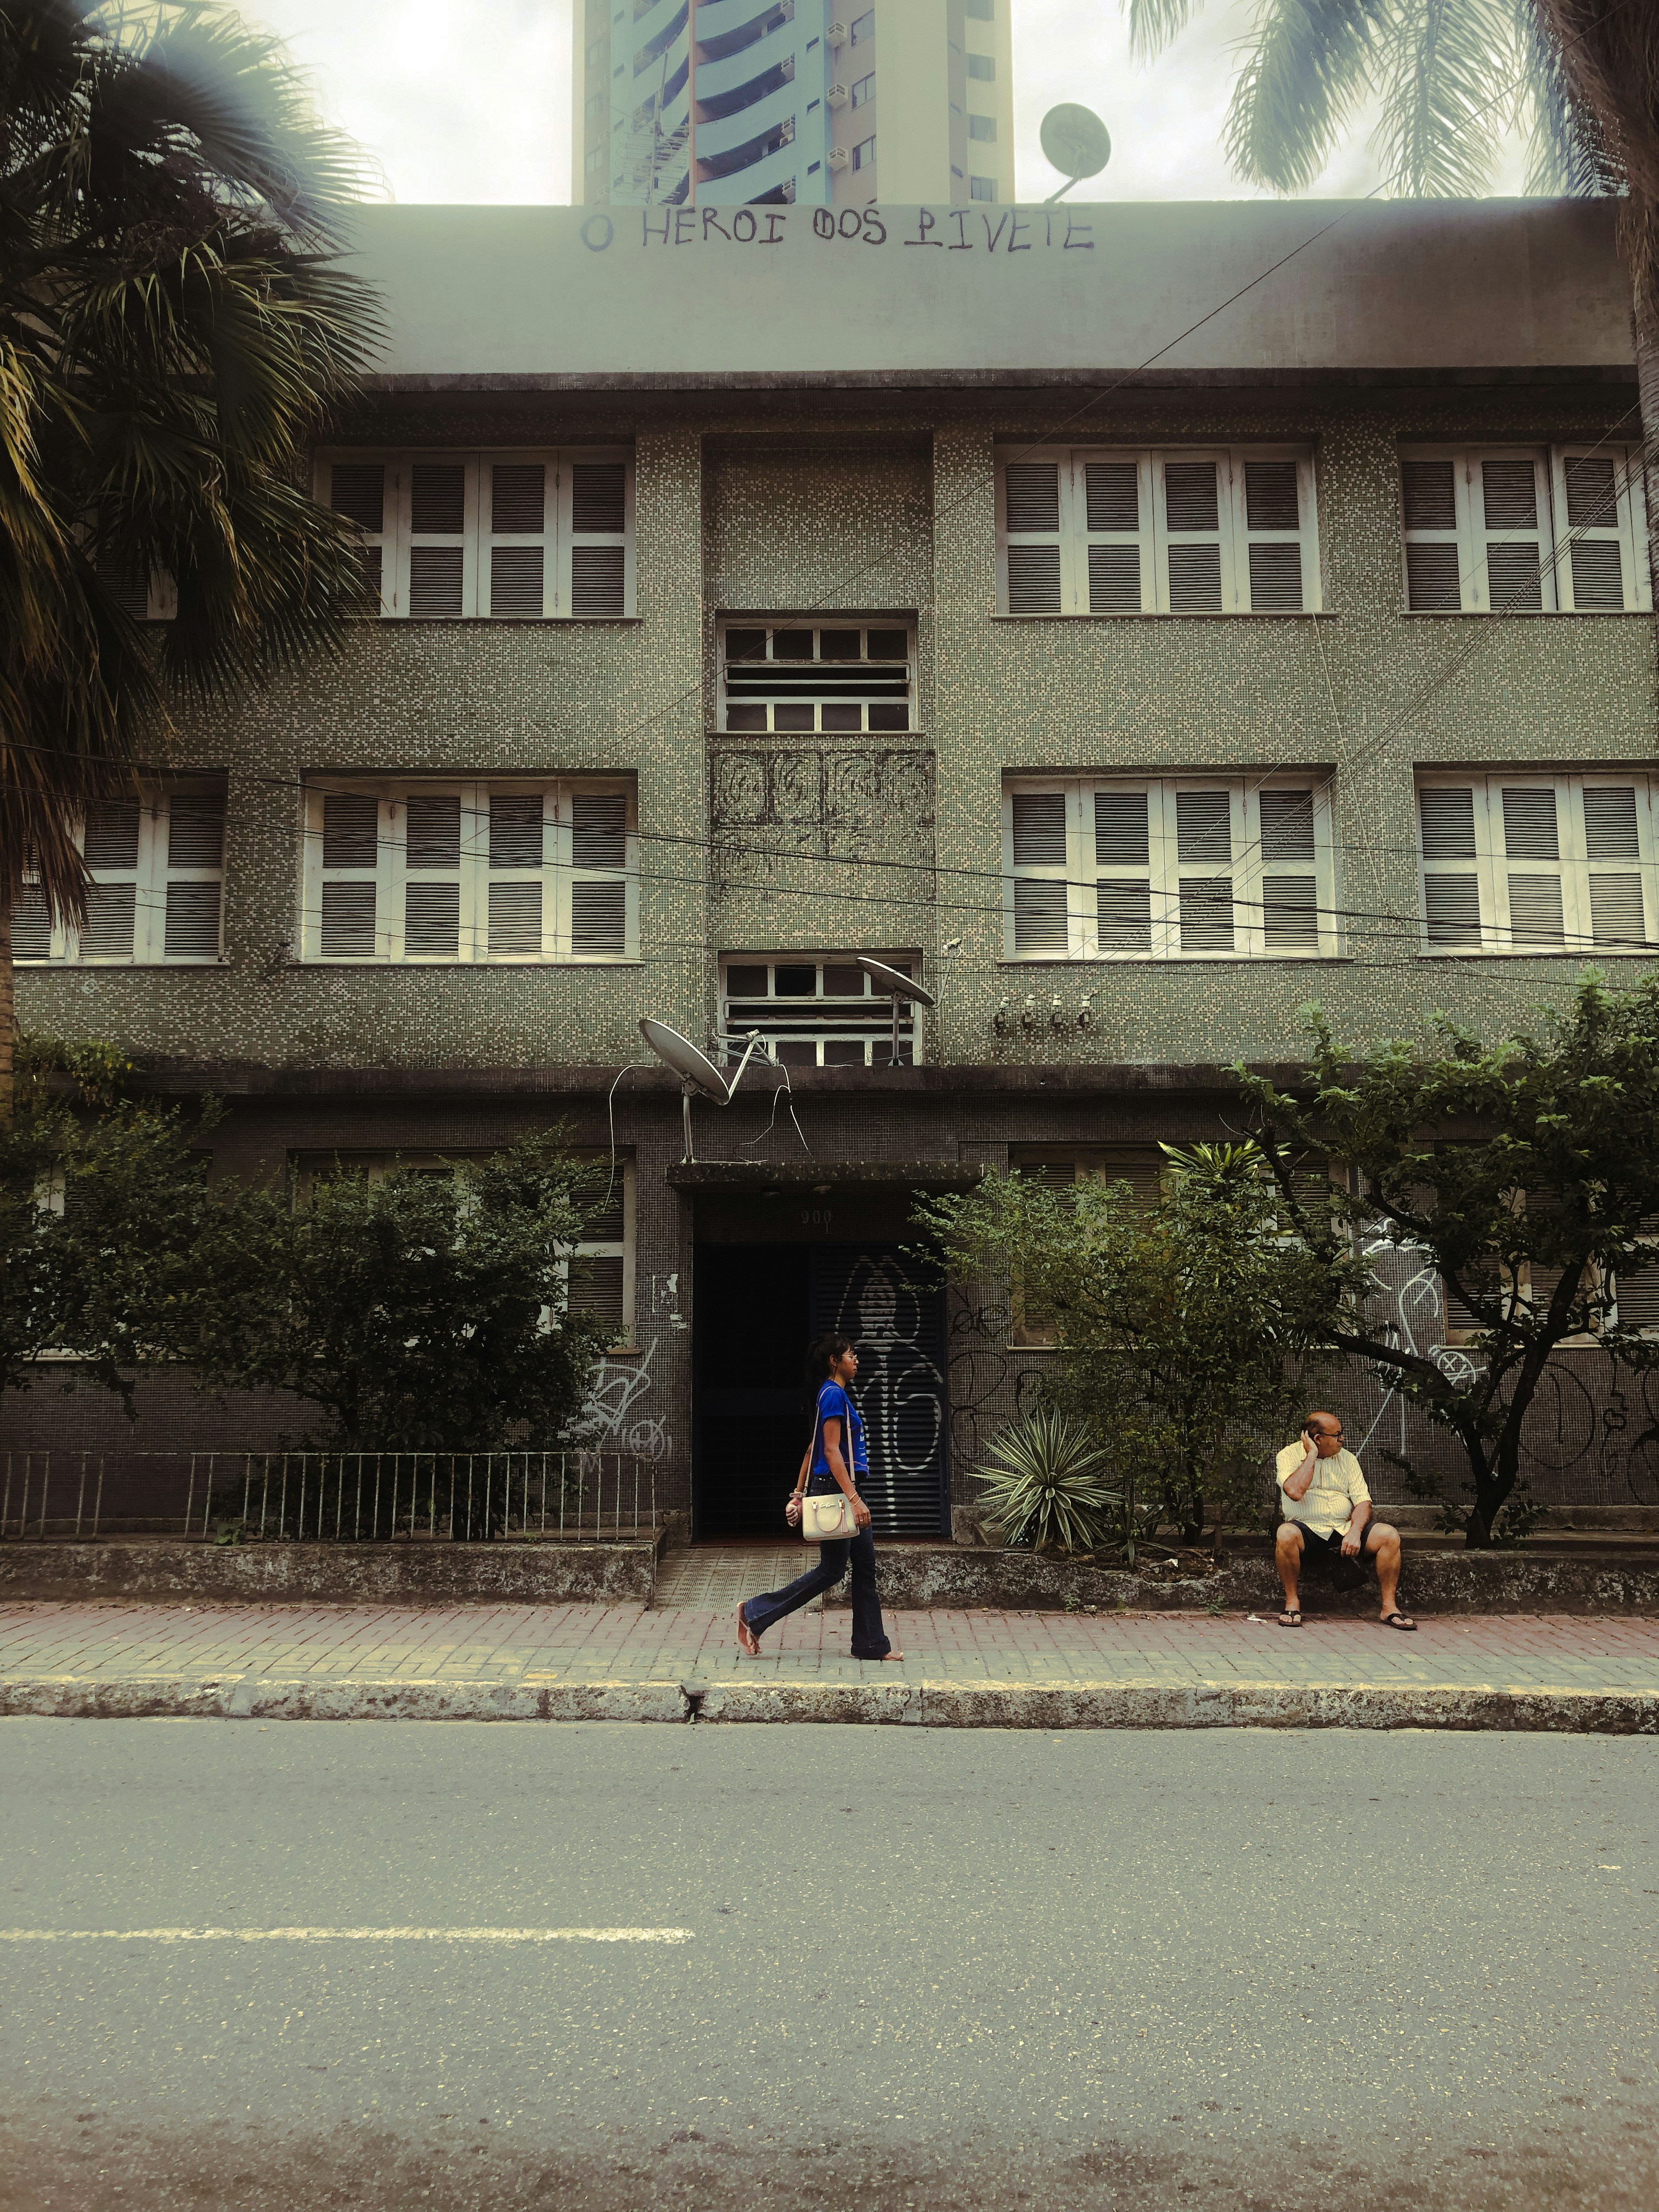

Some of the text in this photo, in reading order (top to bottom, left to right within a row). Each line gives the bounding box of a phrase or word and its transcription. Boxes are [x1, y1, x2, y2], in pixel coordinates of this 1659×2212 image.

[580, 214, 614, 252] O
[642, 207, 786, 246] HEROI
[904, 207, 1094, 252] PIVETE
